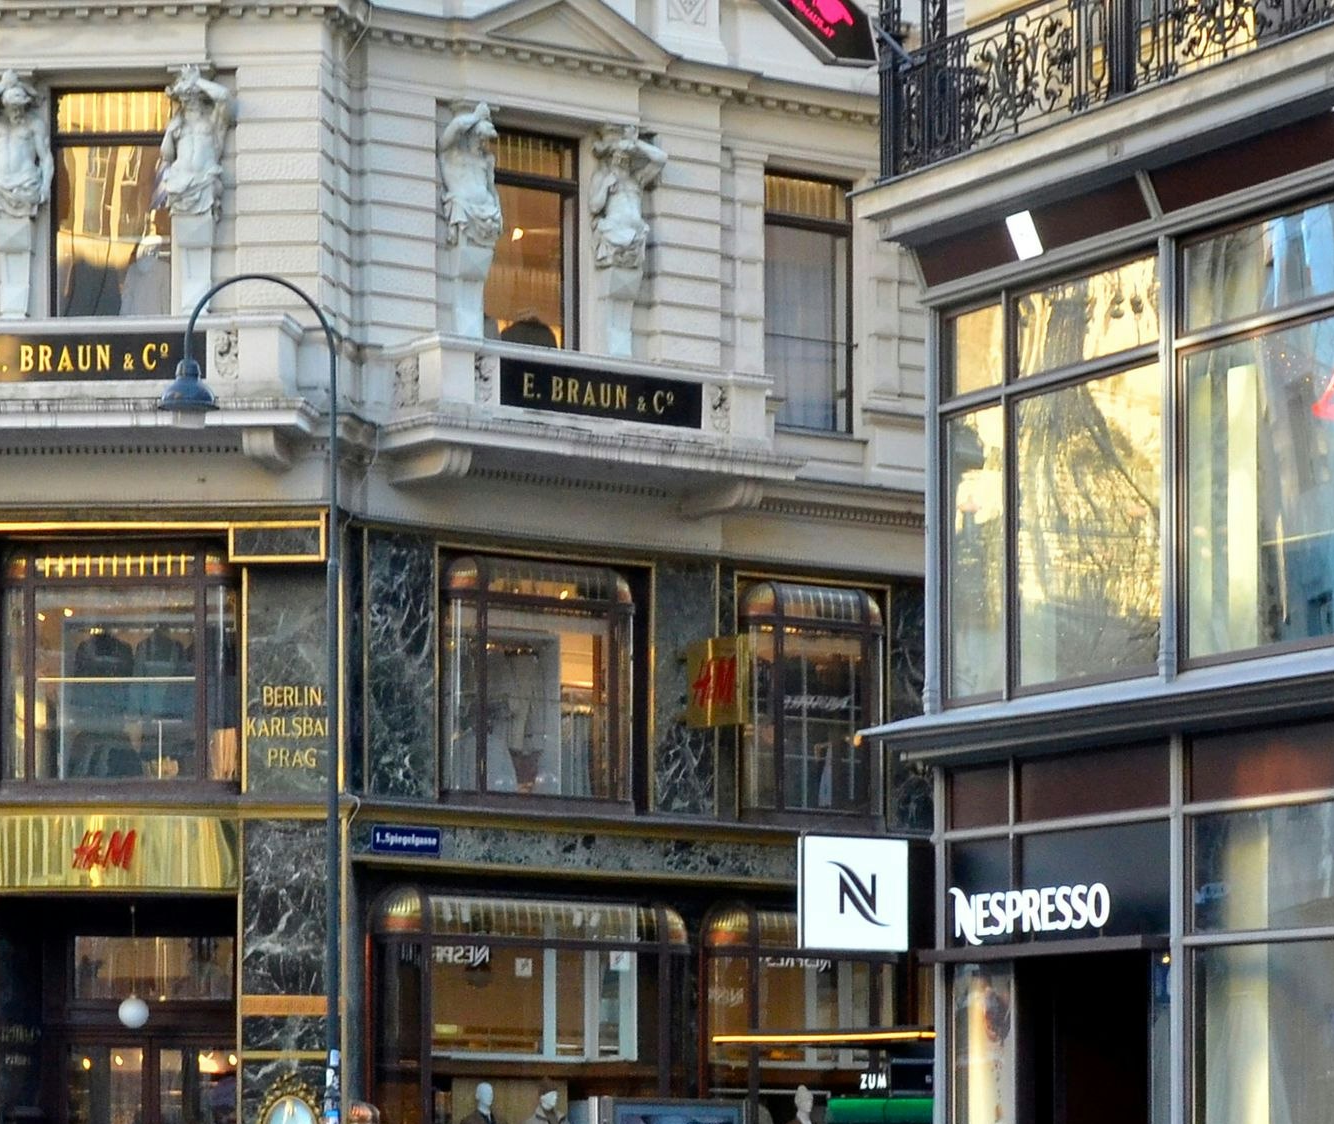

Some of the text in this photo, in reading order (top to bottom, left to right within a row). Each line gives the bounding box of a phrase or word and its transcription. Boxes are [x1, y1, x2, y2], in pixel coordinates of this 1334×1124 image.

[20, 345, 111, 372] BRAUN
[124, 353, 134, 370] &
[523, 373, 541, 399] E.
[552, 376, 628, 410] BRAUN
[637, 396, 647, 413] &
[263, 686, 321, 707] BERLIN
[267, 747, 317, 768] PRAG
[72, 828, 136, 871] H&M
[826, 860, 891, 927] N
[948, 882, 1110, 946] NESPRESSO
[859, 1073, 887, 1090] ZUM
